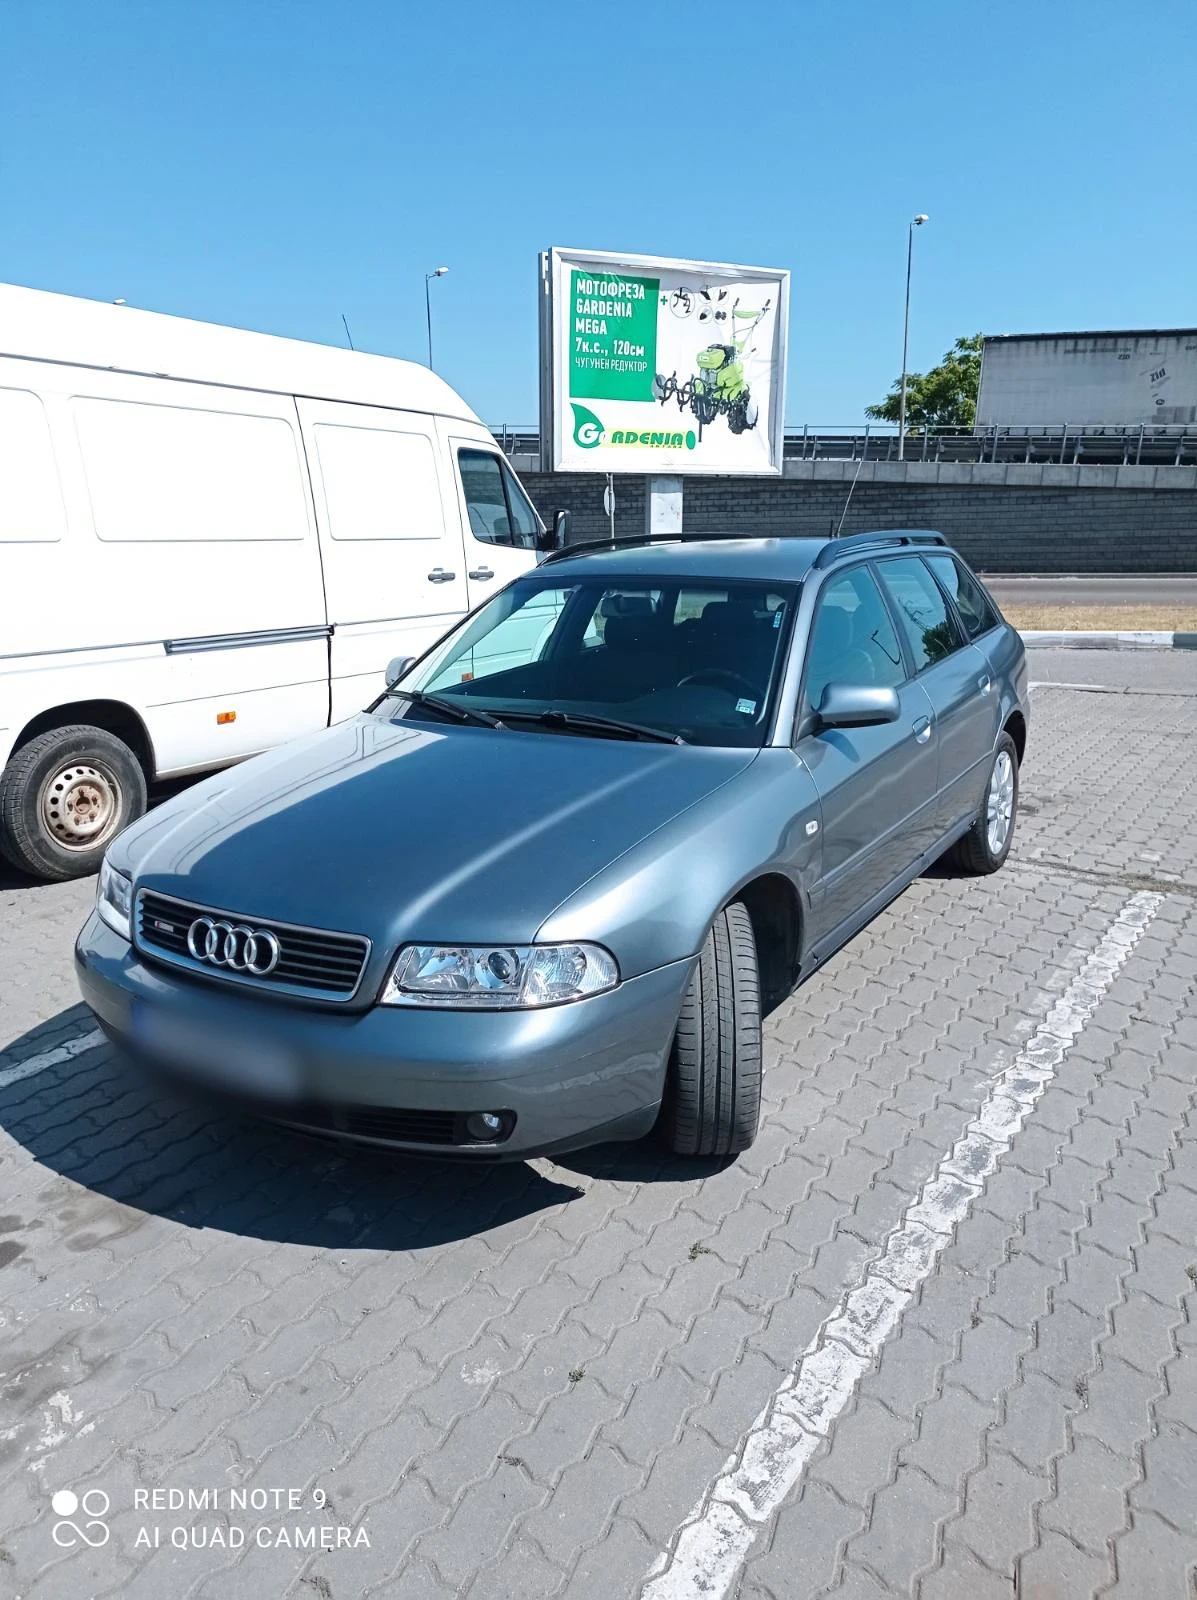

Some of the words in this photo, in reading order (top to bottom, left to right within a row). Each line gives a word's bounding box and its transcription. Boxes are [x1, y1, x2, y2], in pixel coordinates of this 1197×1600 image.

[576, 278, 645, 300] МОТОФРЕЗА
[576, 298, 633, 318] GARDENIA
[575, 317, 608, 335] MEGA
[613, 339, 645, 357] 120см
[575, 356, 610, 370] ЧУГУНЕН
[610, 359, 648, 373] РЕДУКТОР
